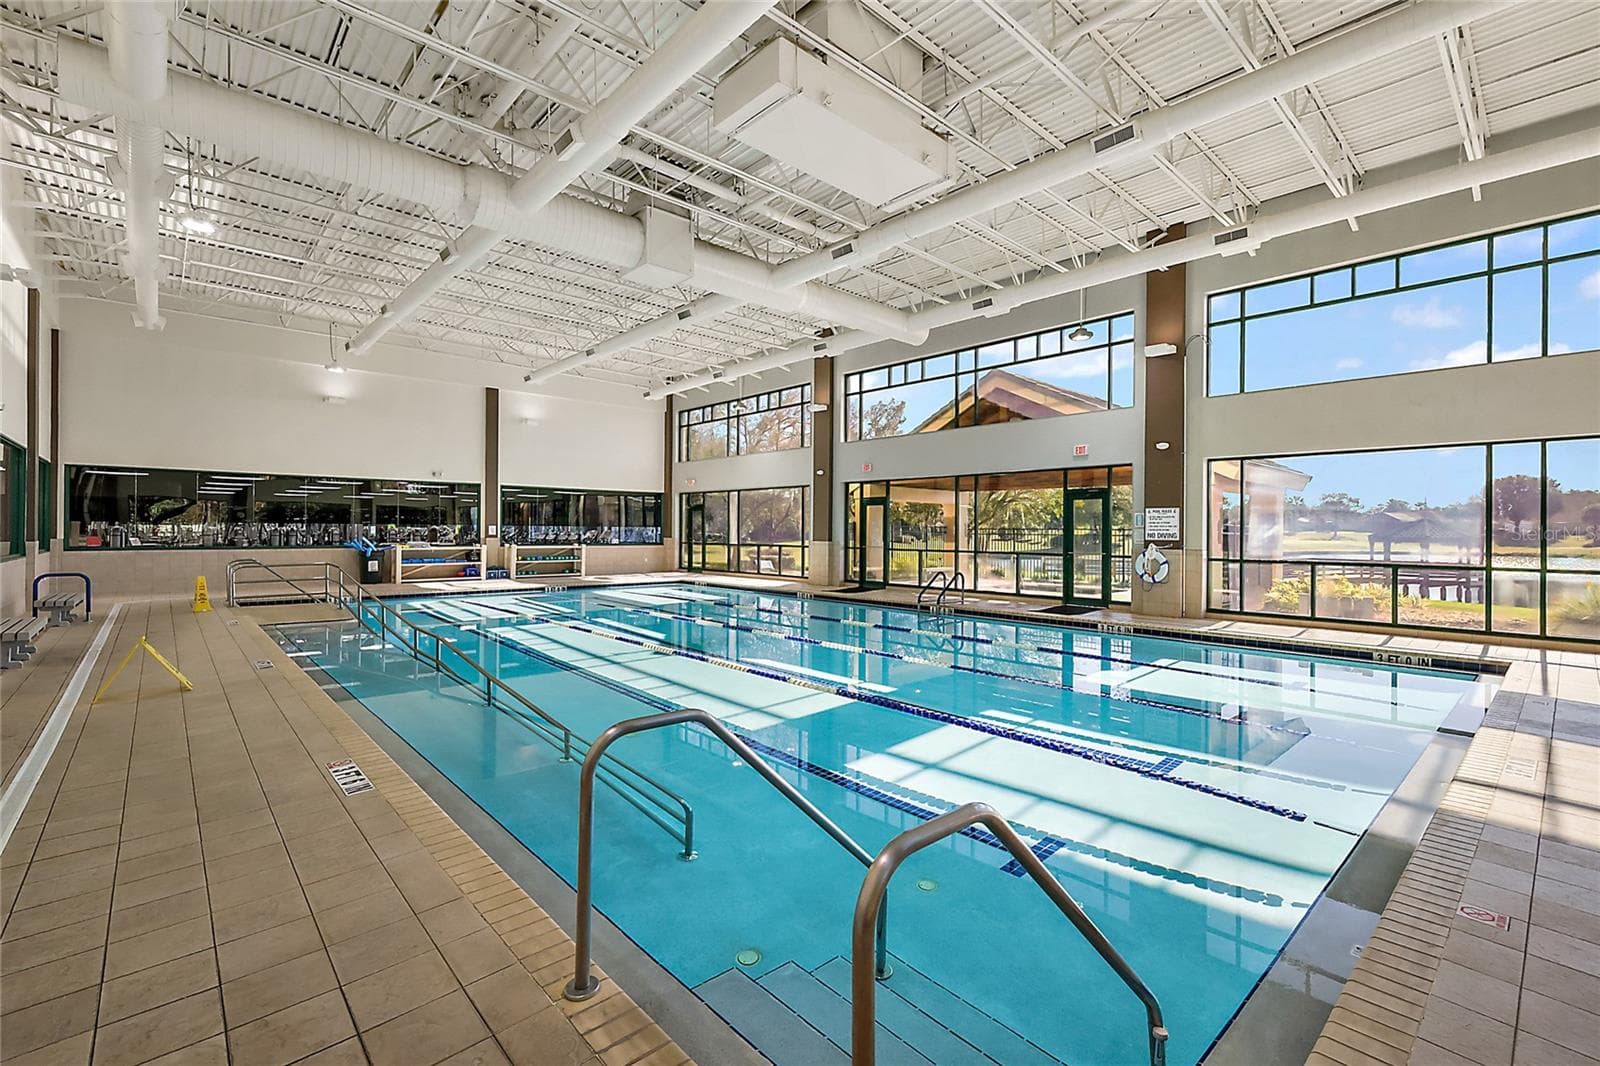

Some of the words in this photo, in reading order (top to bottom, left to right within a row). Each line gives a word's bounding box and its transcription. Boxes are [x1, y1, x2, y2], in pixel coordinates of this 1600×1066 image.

[1075, 446, 1086, 455] EXIT
[1377, 653, 1384, 662] 3
[1388, 655, 1400, 664] FT
[1417, 657, 1430, 667] IN
